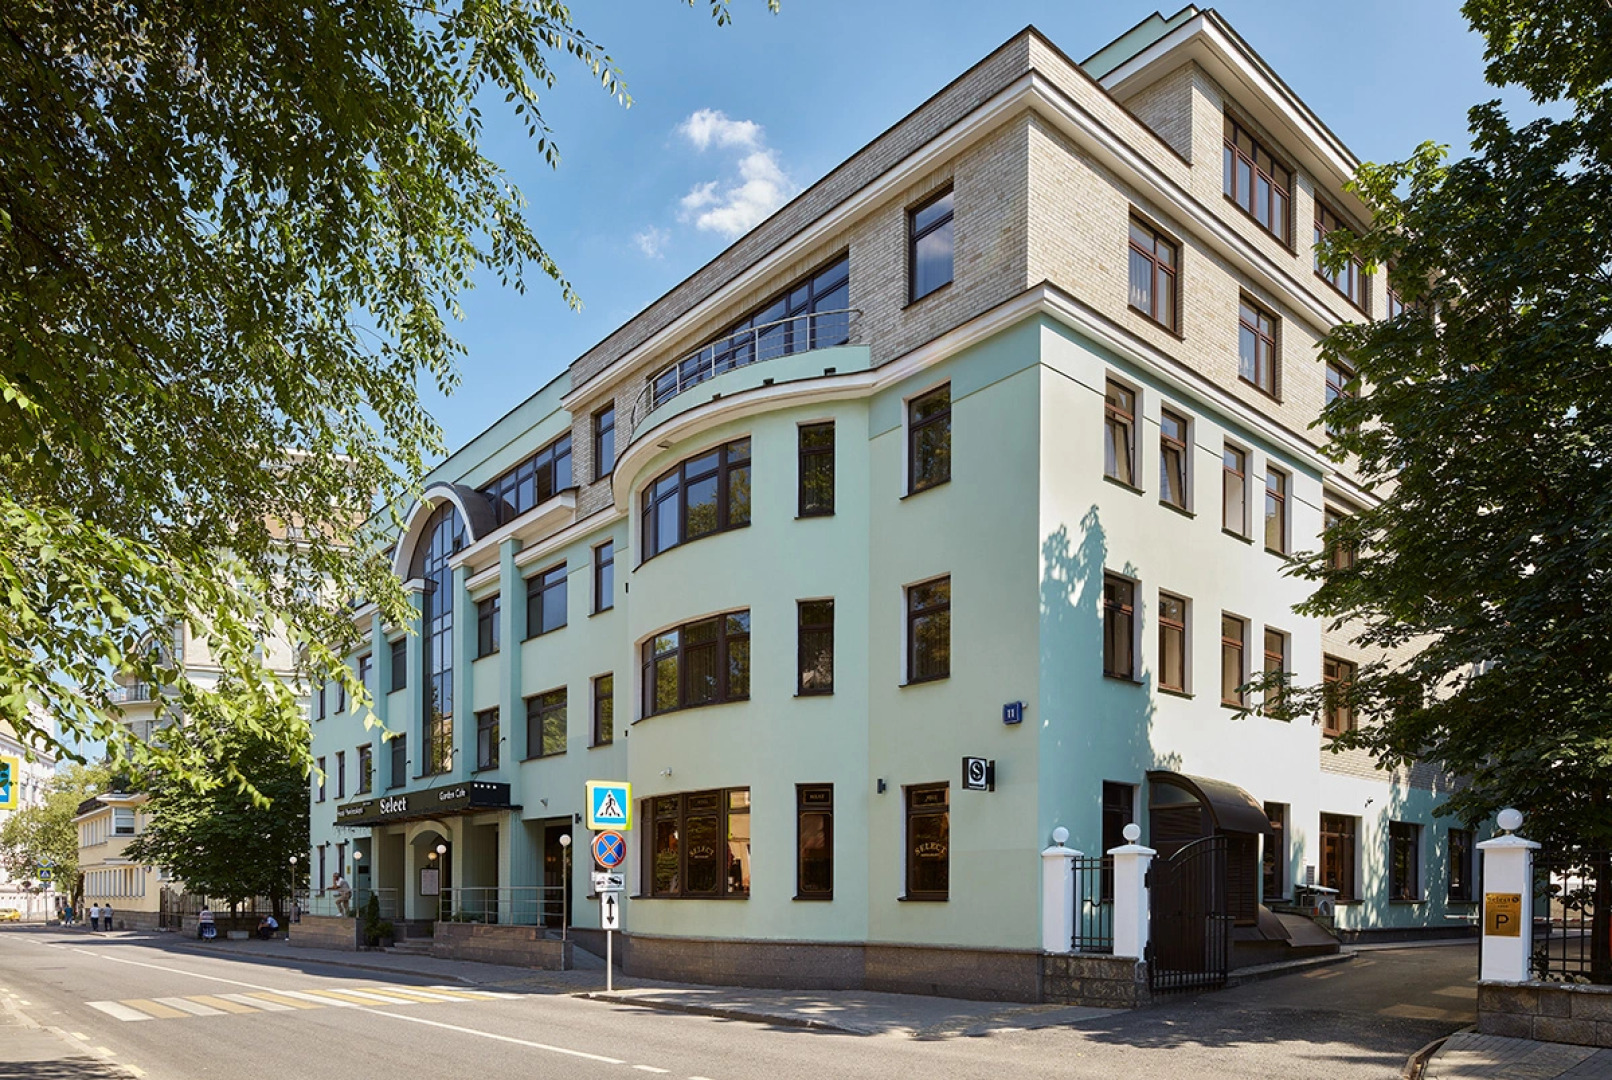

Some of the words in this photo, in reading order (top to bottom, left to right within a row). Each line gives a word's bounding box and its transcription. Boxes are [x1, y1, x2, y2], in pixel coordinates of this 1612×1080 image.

[1007, 708, 1015, 718] 11
[379, 796, 407, 815] Select
[914, 842, 947, 857] SELECT
[1496, 914, 1509, 929] P
